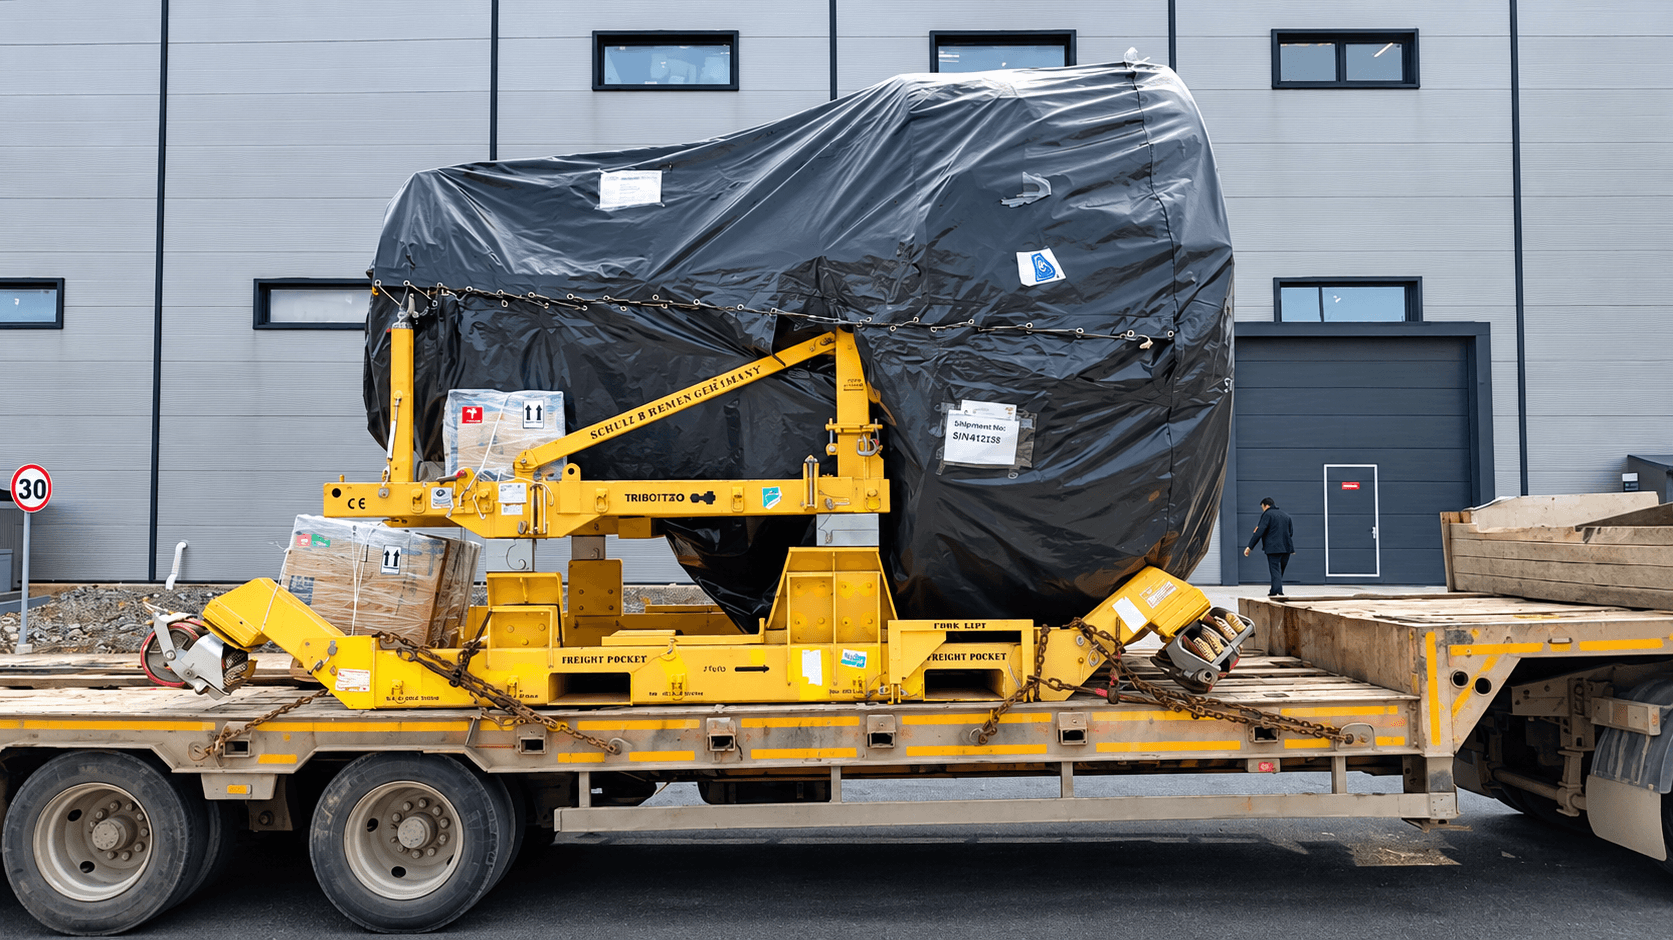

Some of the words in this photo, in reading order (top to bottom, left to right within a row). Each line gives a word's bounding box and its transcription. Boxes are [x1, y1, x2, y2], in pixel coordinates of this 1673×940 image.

[18, 478, 47, 500] 30
[347, 498, 366, 509] CE
[562, 656, 604, 664] FREIGHT
[607, 655, 647, 663] POCKET
